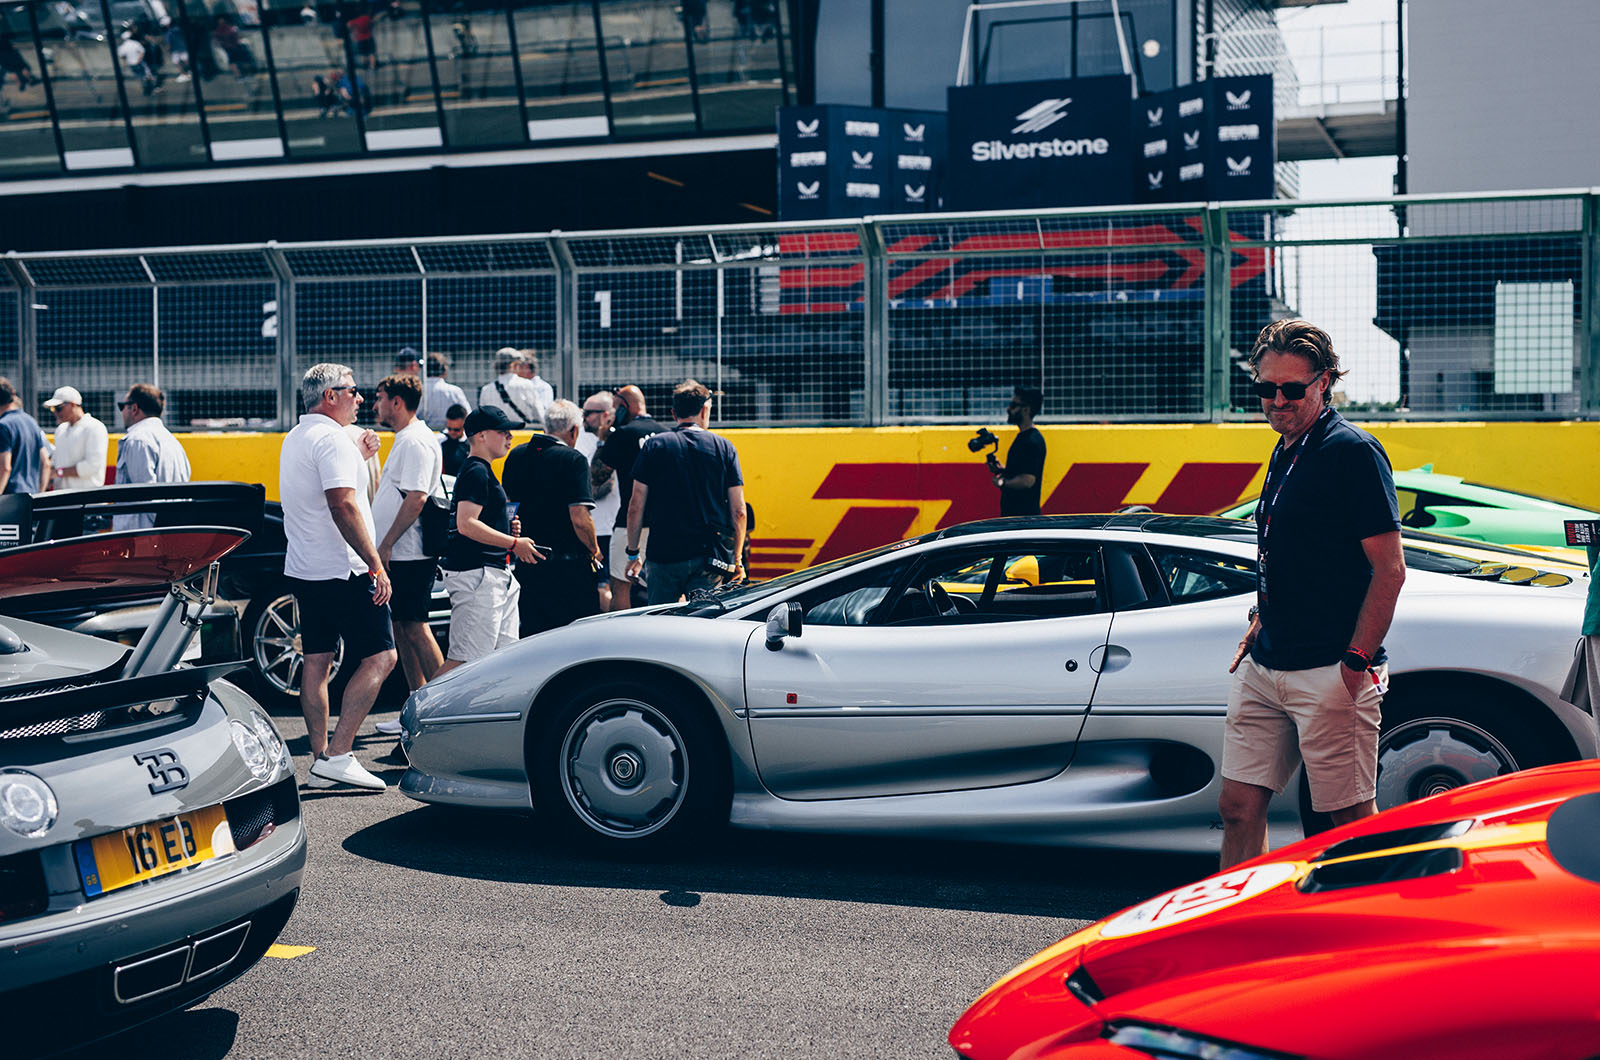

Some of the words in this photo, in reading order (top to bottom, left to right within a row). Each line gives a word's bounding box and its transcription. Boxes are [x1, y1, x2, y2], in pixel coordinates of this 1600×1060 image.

[972, 138, 1109, 161] Silverstone
[594, 291, 612, 328] 1
[1566, 522, 1576, 544] ROAR
[126, 831, 158, 875] 16
[160, 820, 197, 864] EB
